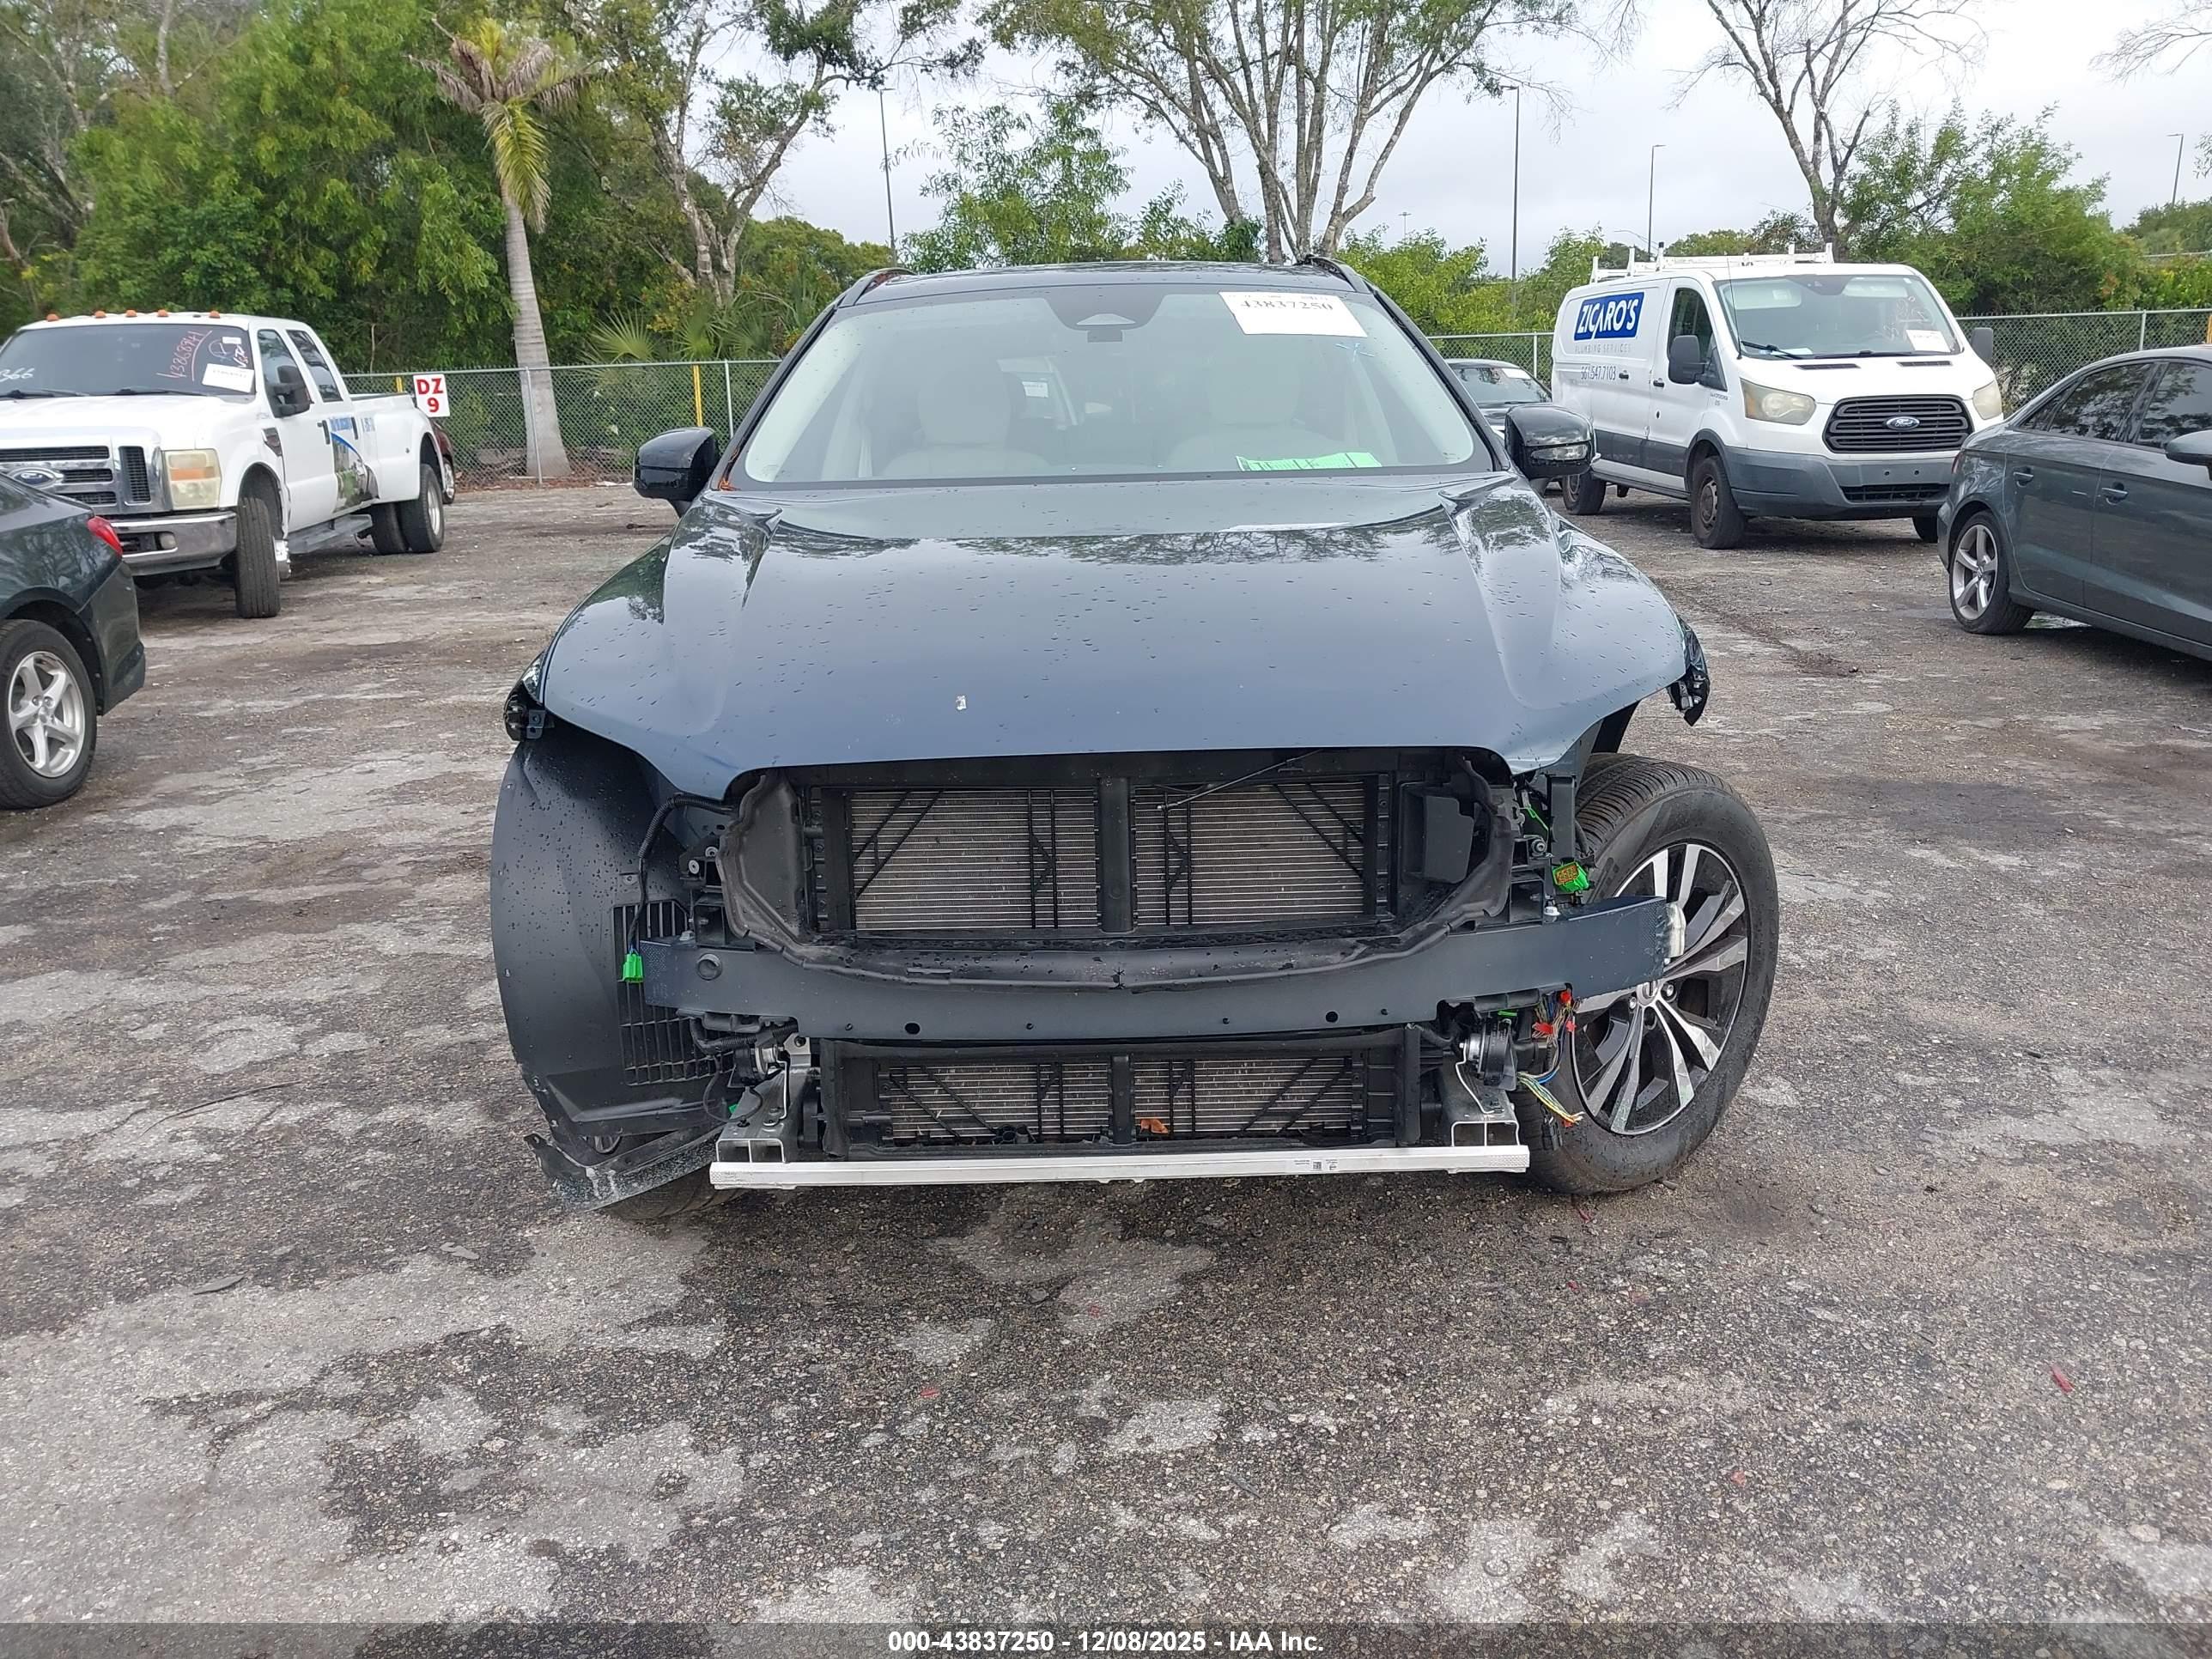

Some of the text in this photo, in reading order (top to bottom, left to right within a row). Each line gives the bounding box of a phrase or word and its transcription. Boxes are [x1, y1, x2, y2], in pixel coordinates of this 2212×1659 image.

[1577, 298, 1639, 337] ZICARO'S
[416, 377, 444, 395] DZ
[427, 397, 440, 413] 9
